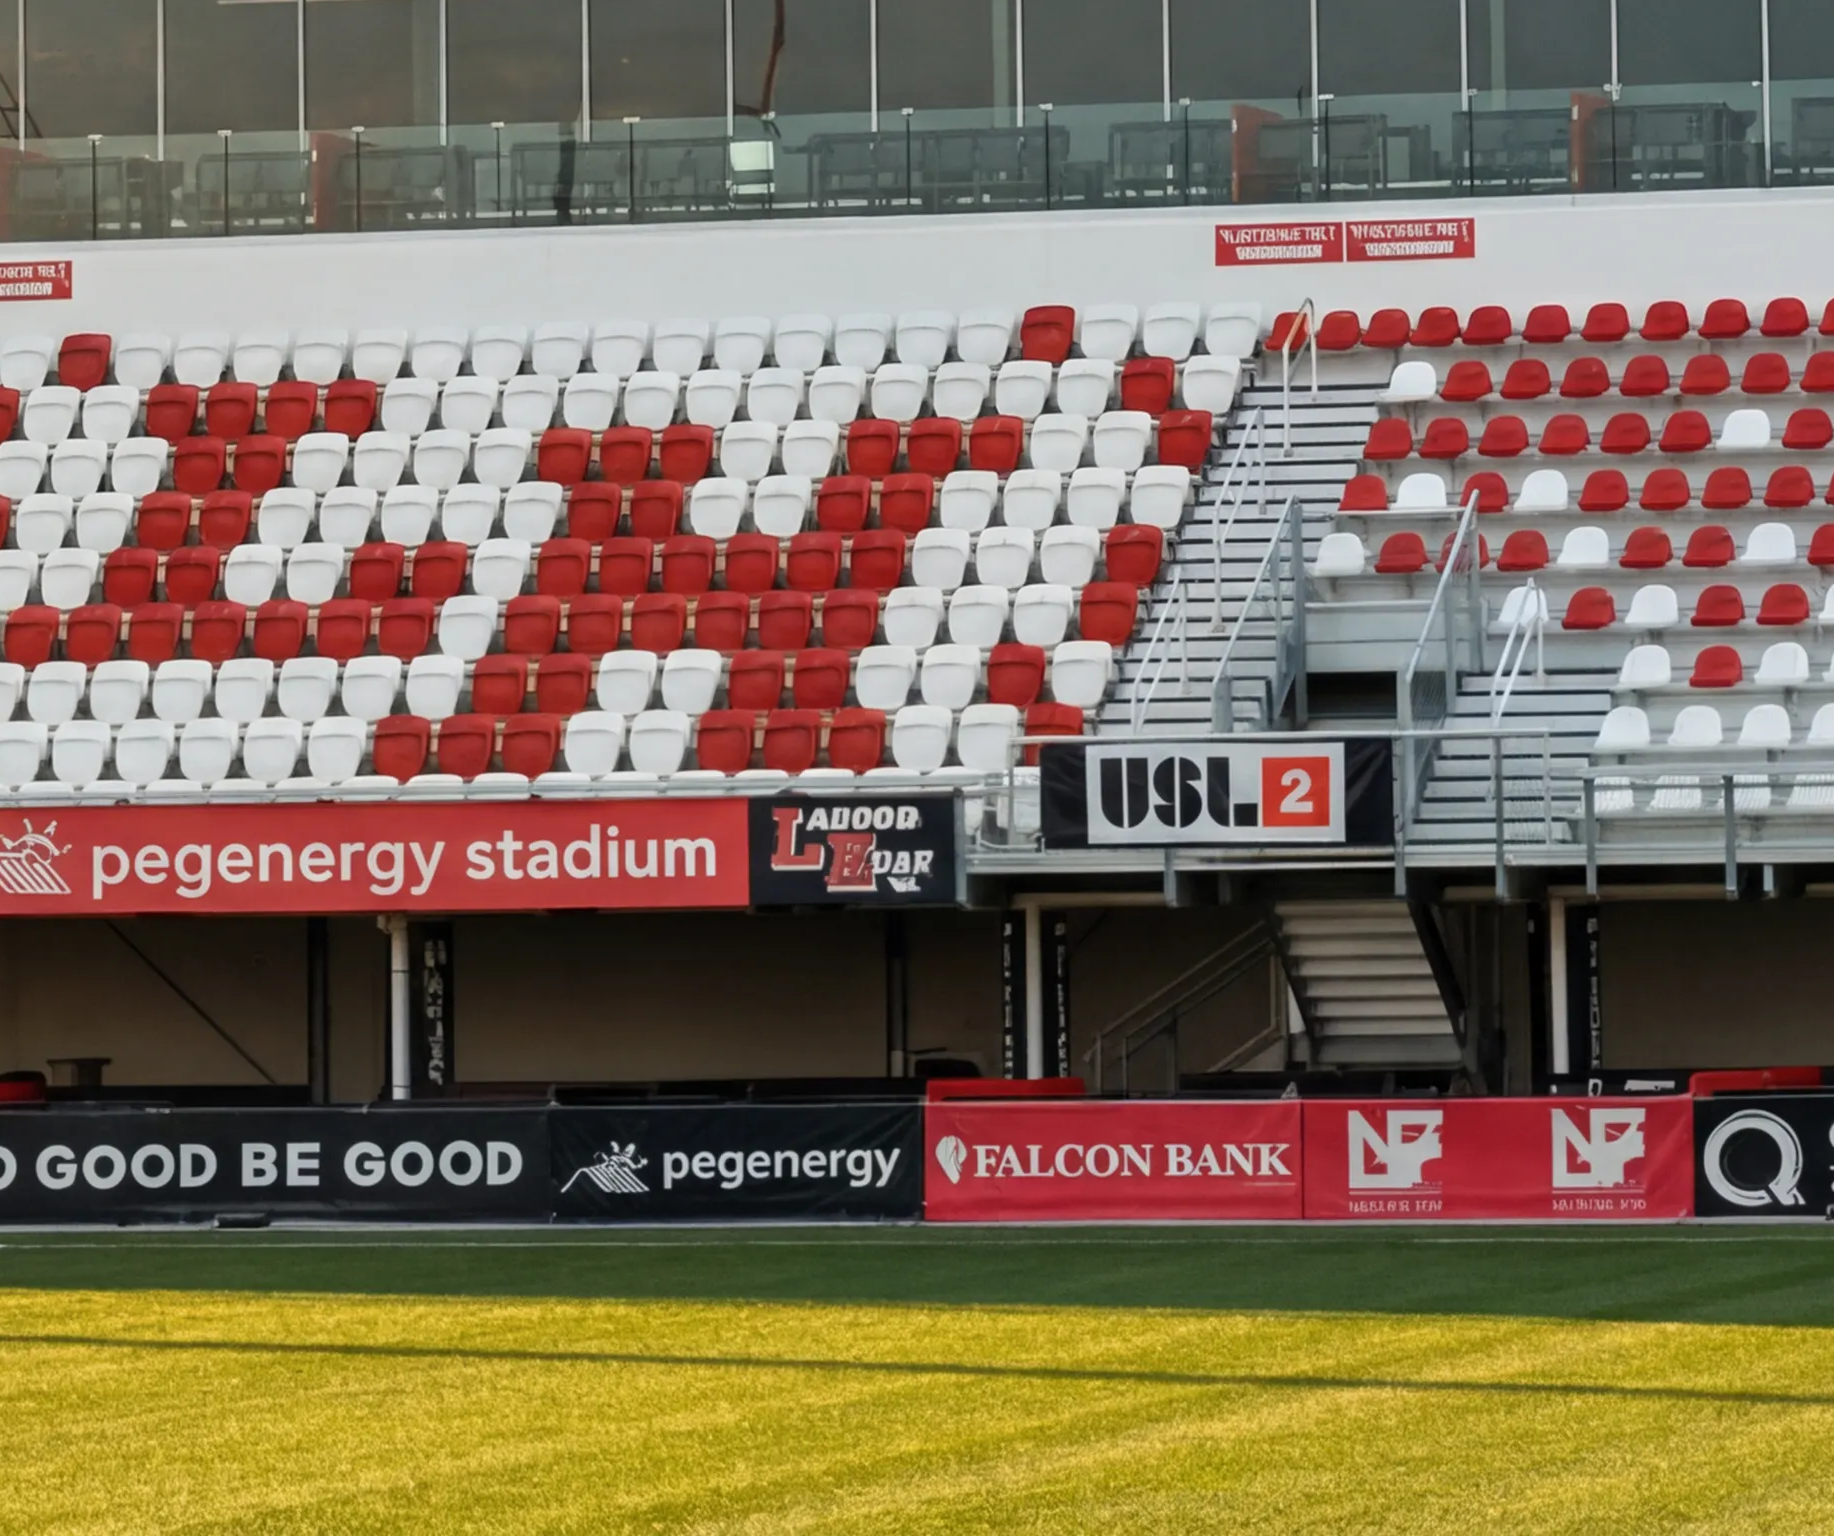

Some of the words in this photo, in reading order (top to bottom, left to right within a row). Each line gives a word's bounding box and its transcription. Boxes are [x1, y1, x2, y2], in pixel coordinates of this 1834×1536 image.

[1099, 756, 1258, 829] USL
[1279, 767, 1314, 814] 2
[92, 841, 446, 900] pegenergy
[466, 823, 717, 880] stadium
[35, 1143, 218, 1190] GOOD
[241, 1142, 321, 1187] BE
[343, 1139, 523, 1187] GOOD
[663, 1147, 901, 1190] pegenergy
[973, 1143, 1154, 1178] FALCON
[1164, 1143, 1292, 1177] BANK
